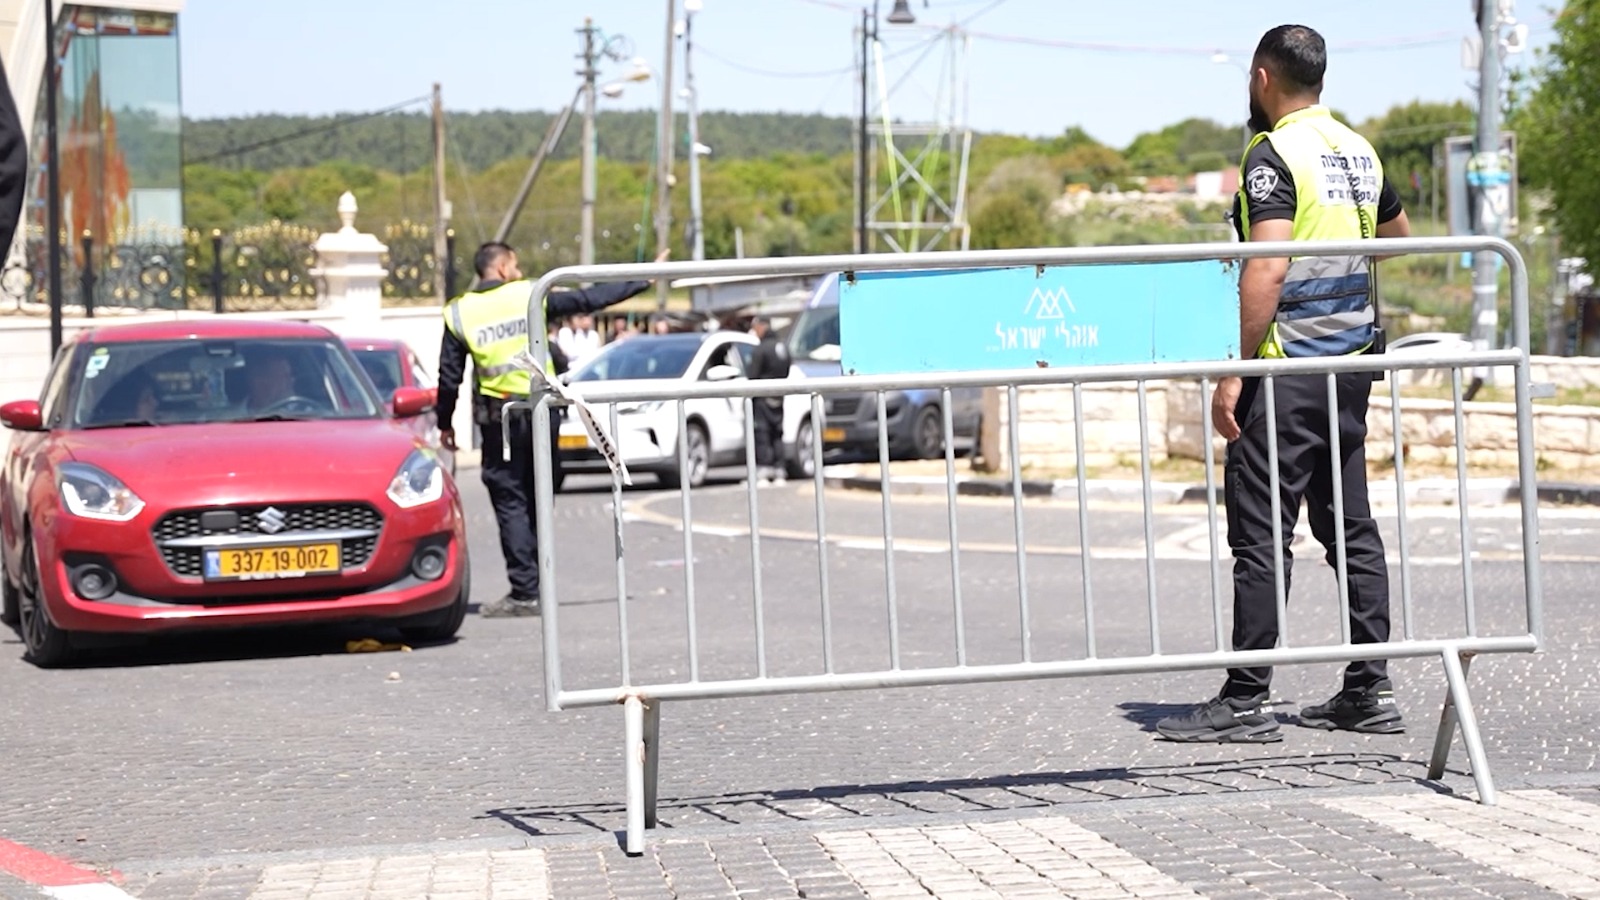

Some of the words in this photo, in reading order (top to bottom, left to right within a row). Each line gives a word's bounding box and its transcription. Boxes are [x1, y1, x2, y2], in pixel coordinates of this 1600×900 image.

[476, 318, 527, 347] משטרה
[995, 321, 1046, 350] ישראל
[1055, 320, 1099, 348] אוהלי
